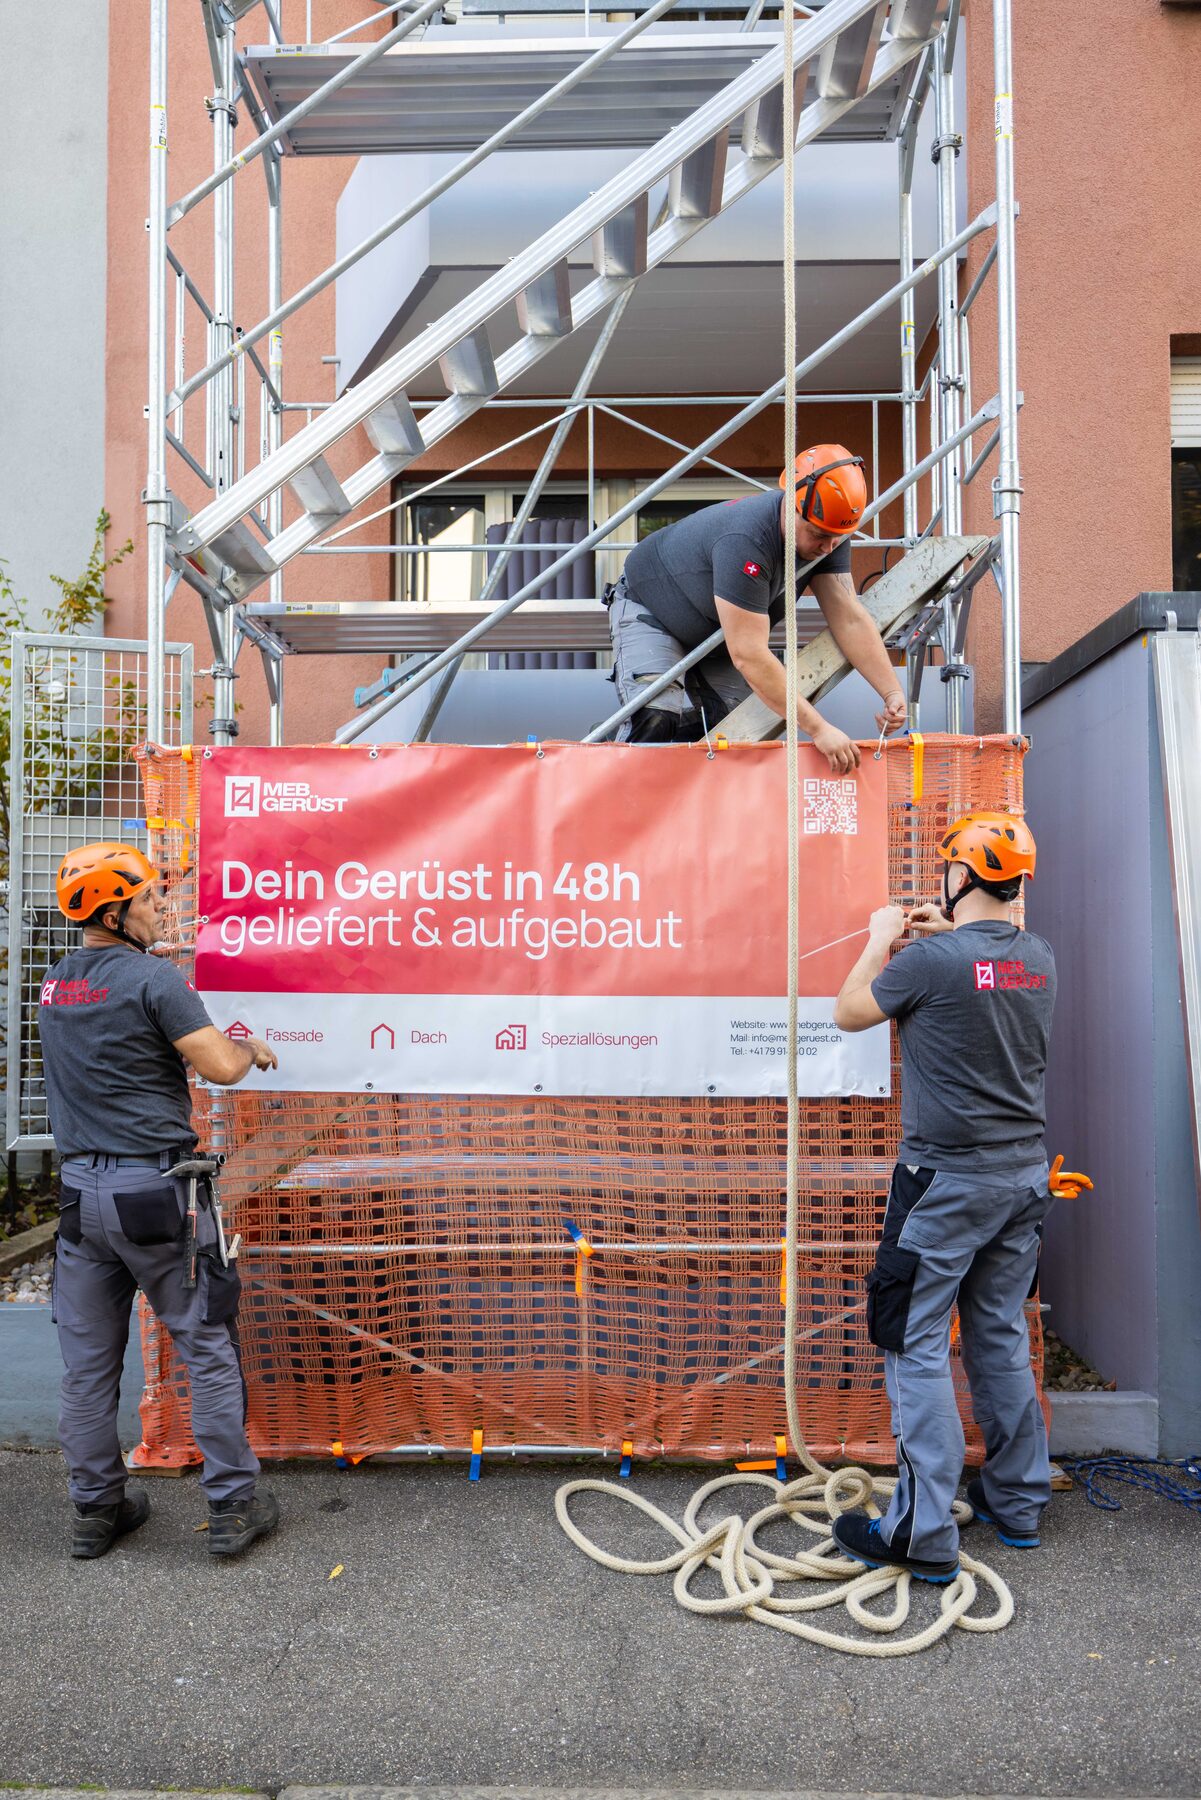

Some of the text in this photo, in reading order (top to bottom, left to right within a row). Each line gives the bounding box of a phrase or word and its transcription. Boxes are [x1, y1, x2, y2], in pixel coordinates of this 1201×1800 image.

[263, 782, 310, 796] MEB
[262, 794, 348, 812] GERÜST
[222, 860, 640, 901] Dein Gerüst in 48h
[219, 906, 682, 960] geliefert & aufgebaut
[730, 1020, 768, 1029] Website:
[265, 1028, 324, 1043] Fassade
[411, 1030, 447, 1044] Dach
[541, 1031, 658, 1050] Speziallösungen
[730, 1034, 842, 1044] Mail: info@megeruest.ch
[765, 1047, 776, 1056] 79
